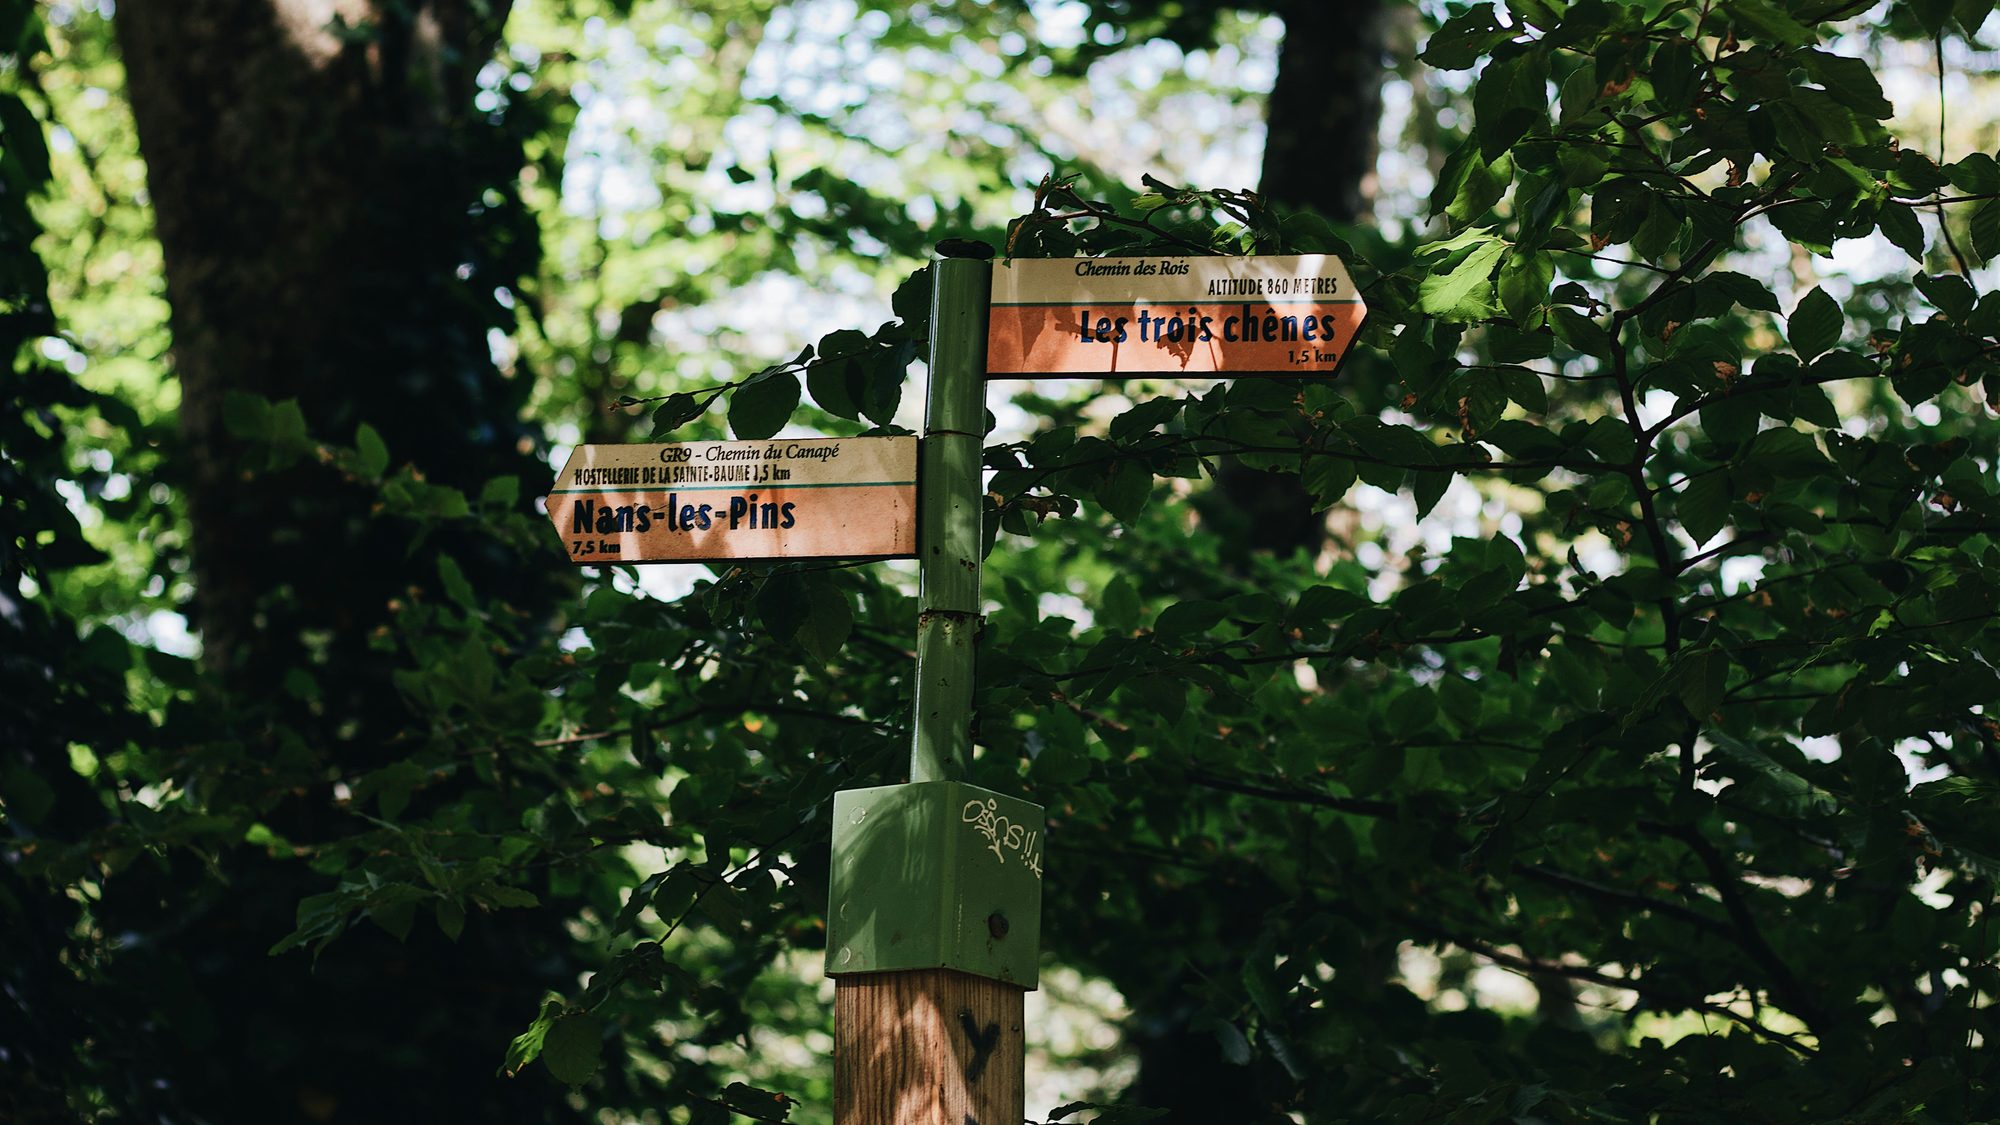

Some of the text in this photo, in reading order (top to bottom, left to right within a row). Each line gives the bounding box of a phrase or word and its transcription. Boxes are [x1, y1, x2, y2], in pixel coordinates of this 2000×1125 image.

[1074, 260, 1190, 277] Chemin des Rois
[1208, 278, 1263, 296] ALTITUDE
[1267, 277, 1288, 294] 860
[1080, 304, 1335, 344] Les trois chênes
[1288, 349, 1337, 365] 1,5 km
[660, 446, 692, 463] GR9
[705, 445, 760, 462] Chemin
[763, 444, 782, 460] du
[785, 443, 840, 463] Canapé
[574, 466, 640, 486] HOSTELLERIE
[642, 466, 657, 484] DE
[658, 466, 671, 484] LA
[672, 464, 751, 483] SAINTE-BAUME
[771, 463, 791, 481] km
[573, 493, 796, 535] Nans-les-Pins
[572, 540, 621, 555] 7,5 km
